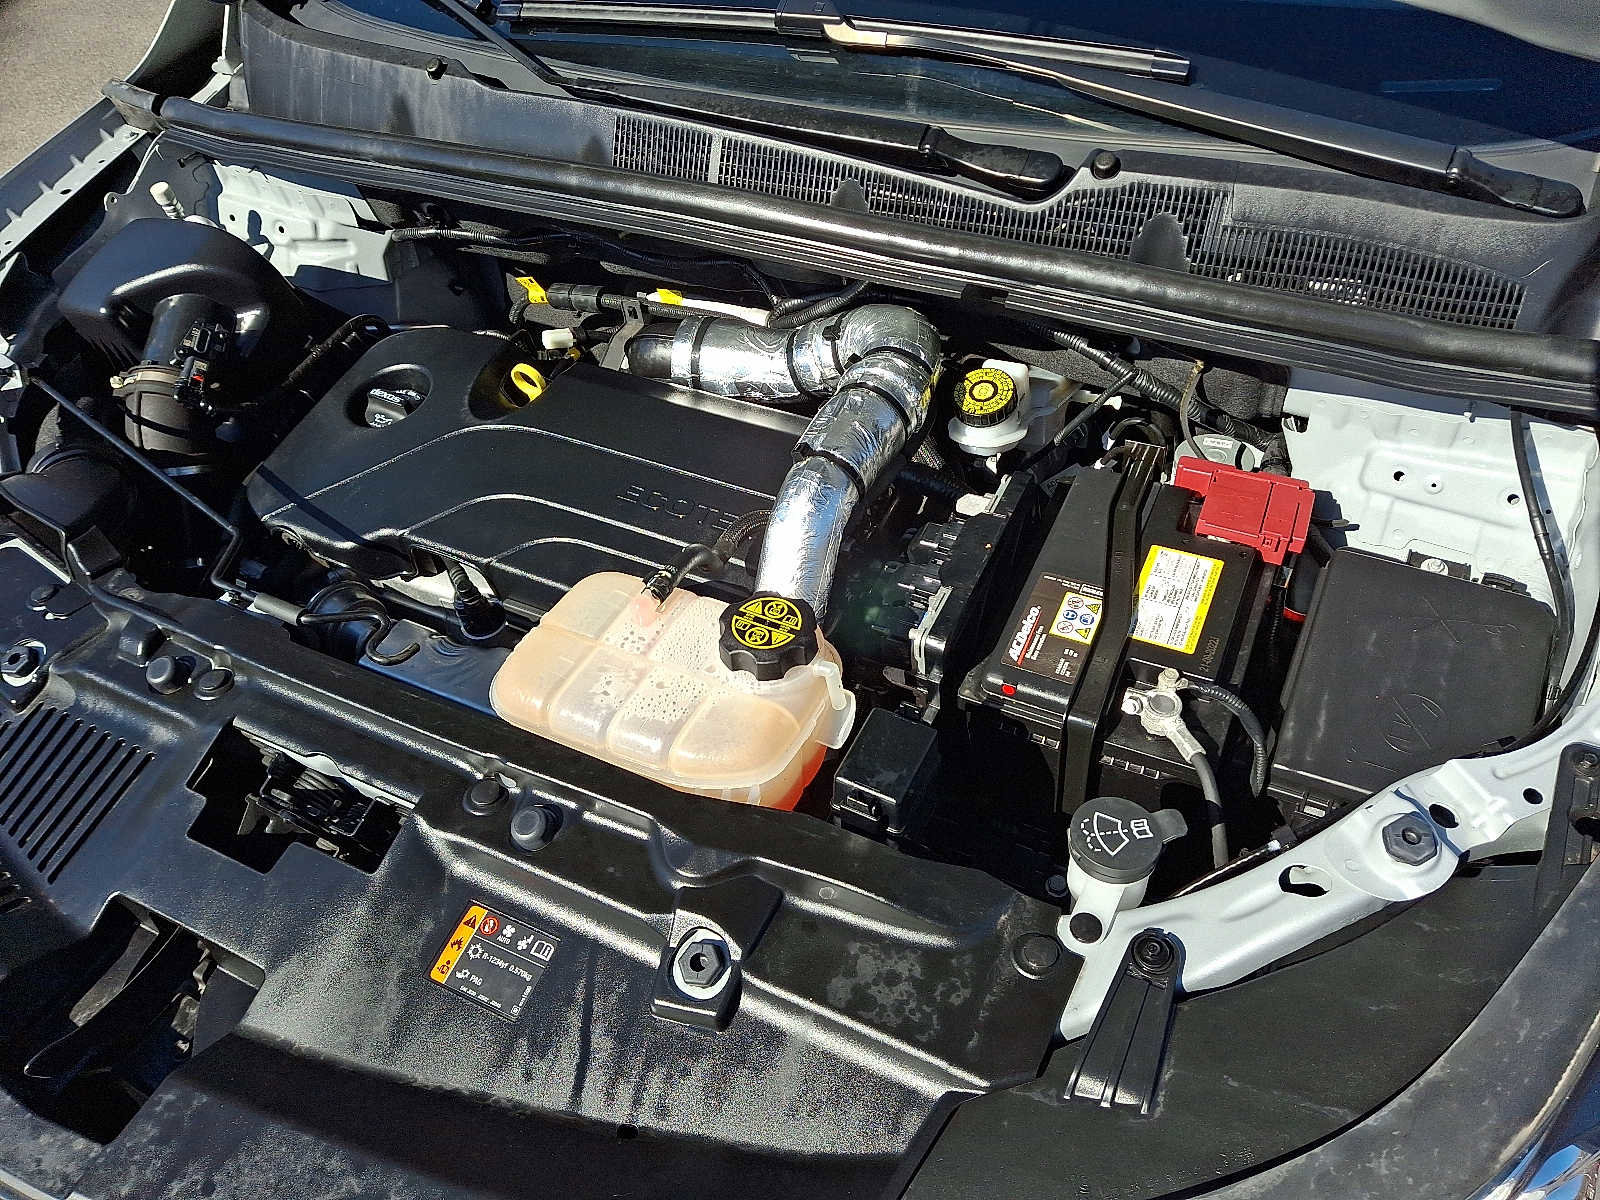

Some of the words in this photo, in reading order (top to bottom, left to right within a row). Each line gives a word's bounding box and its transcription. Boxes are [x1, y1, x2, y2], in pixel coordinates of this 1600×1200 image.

[370, 388, 401, 403] dexos
[616, 485, 739, 531] ECOTE
[469, 974, 483, 986] PAG
